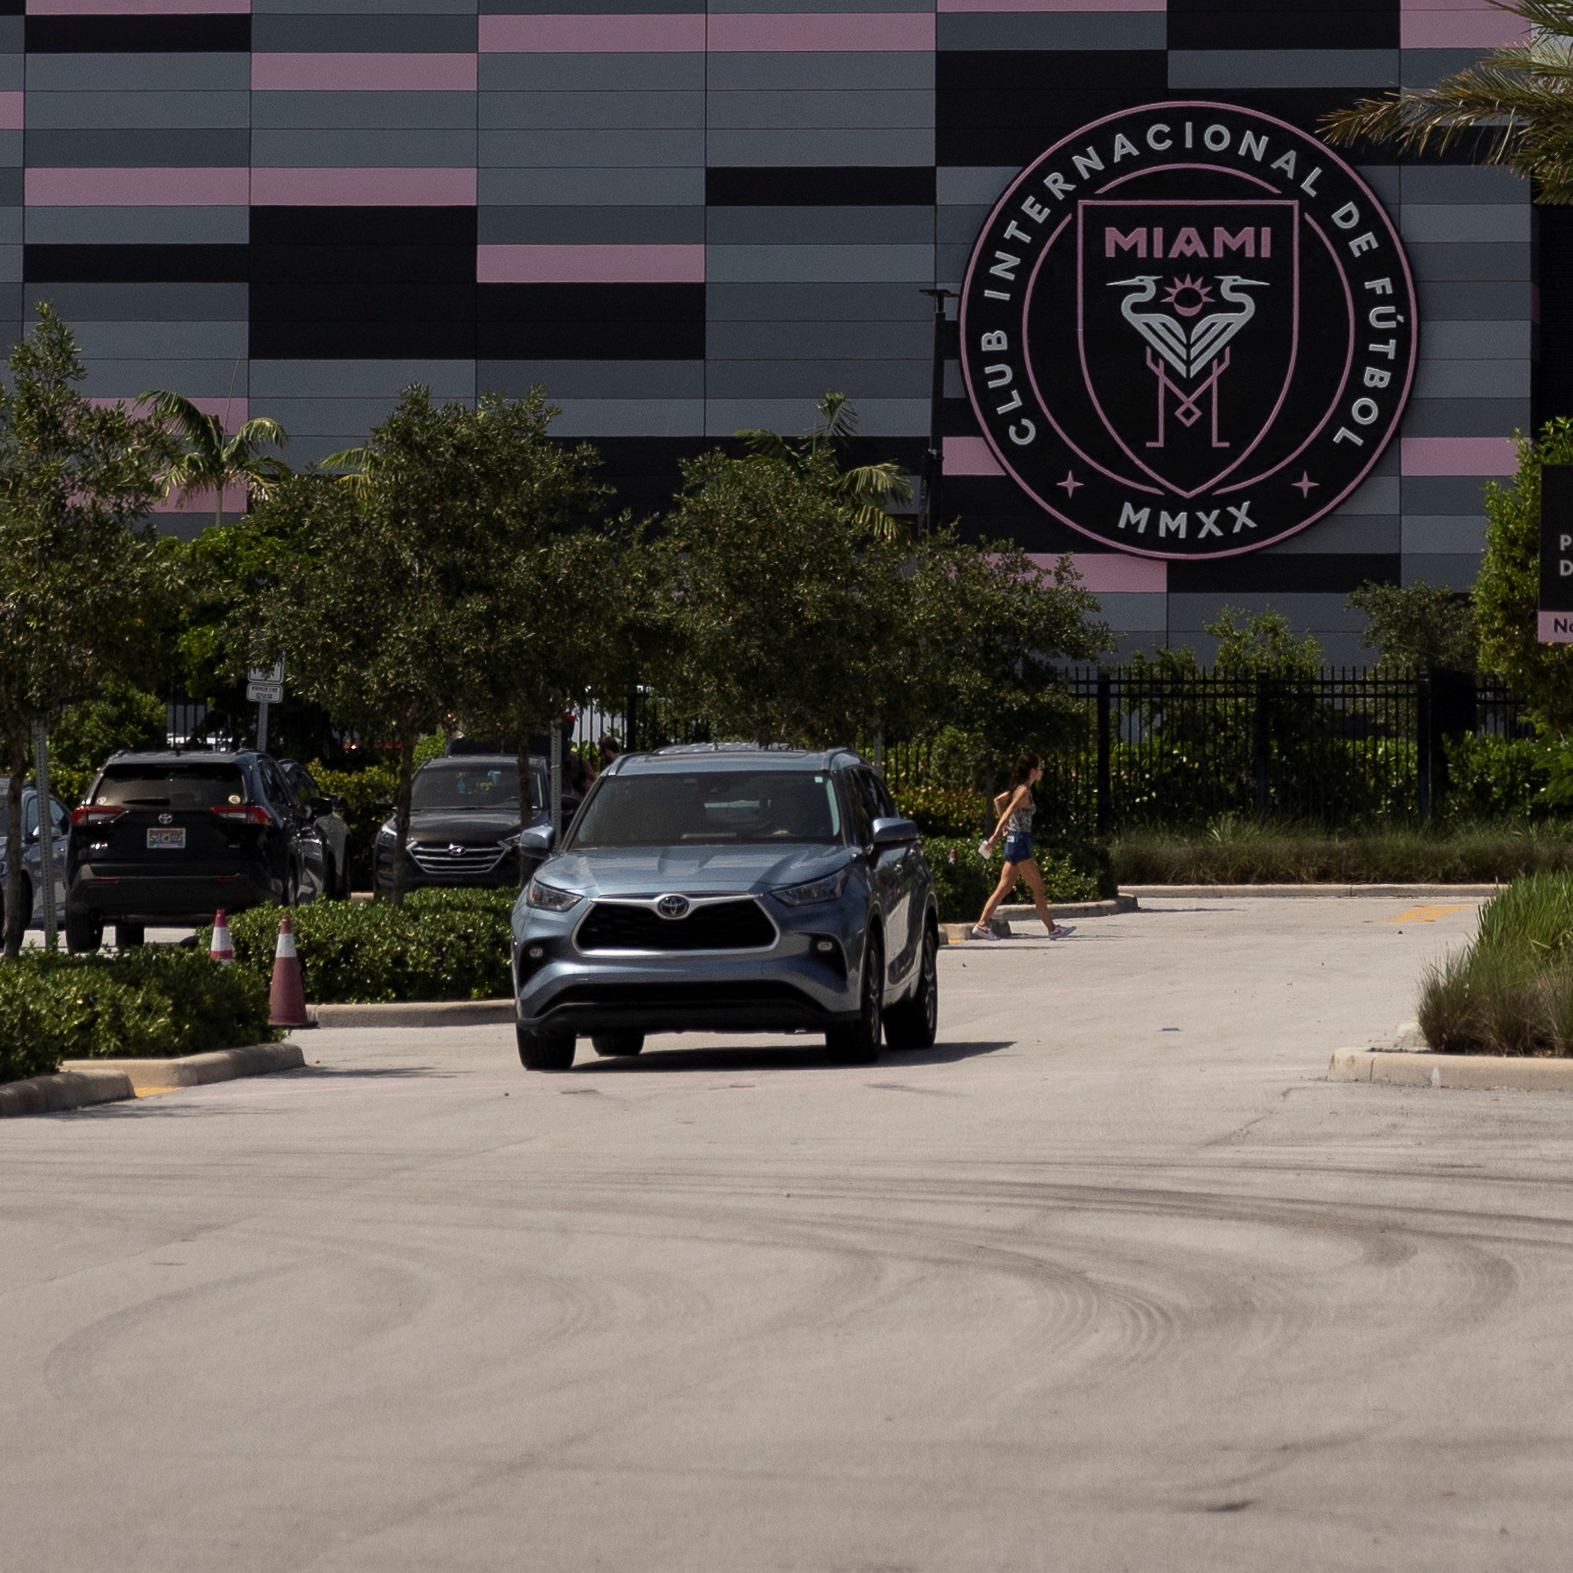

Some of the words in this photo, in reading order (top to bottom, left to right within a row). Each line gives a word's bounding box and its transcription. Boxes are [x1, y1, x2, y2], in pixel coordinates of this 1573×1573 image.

[984, 121, 1323, 301] INTERNACIONAL
[1105, 226, 1271, 258] MIAMI
[1331, 201, 1379, 257] DE
[981, 329, 1036, 446] CLUB
[1332, 277, 1404, 447] FÚTBOL
[1117, 500, 1258, 539] MMXX
